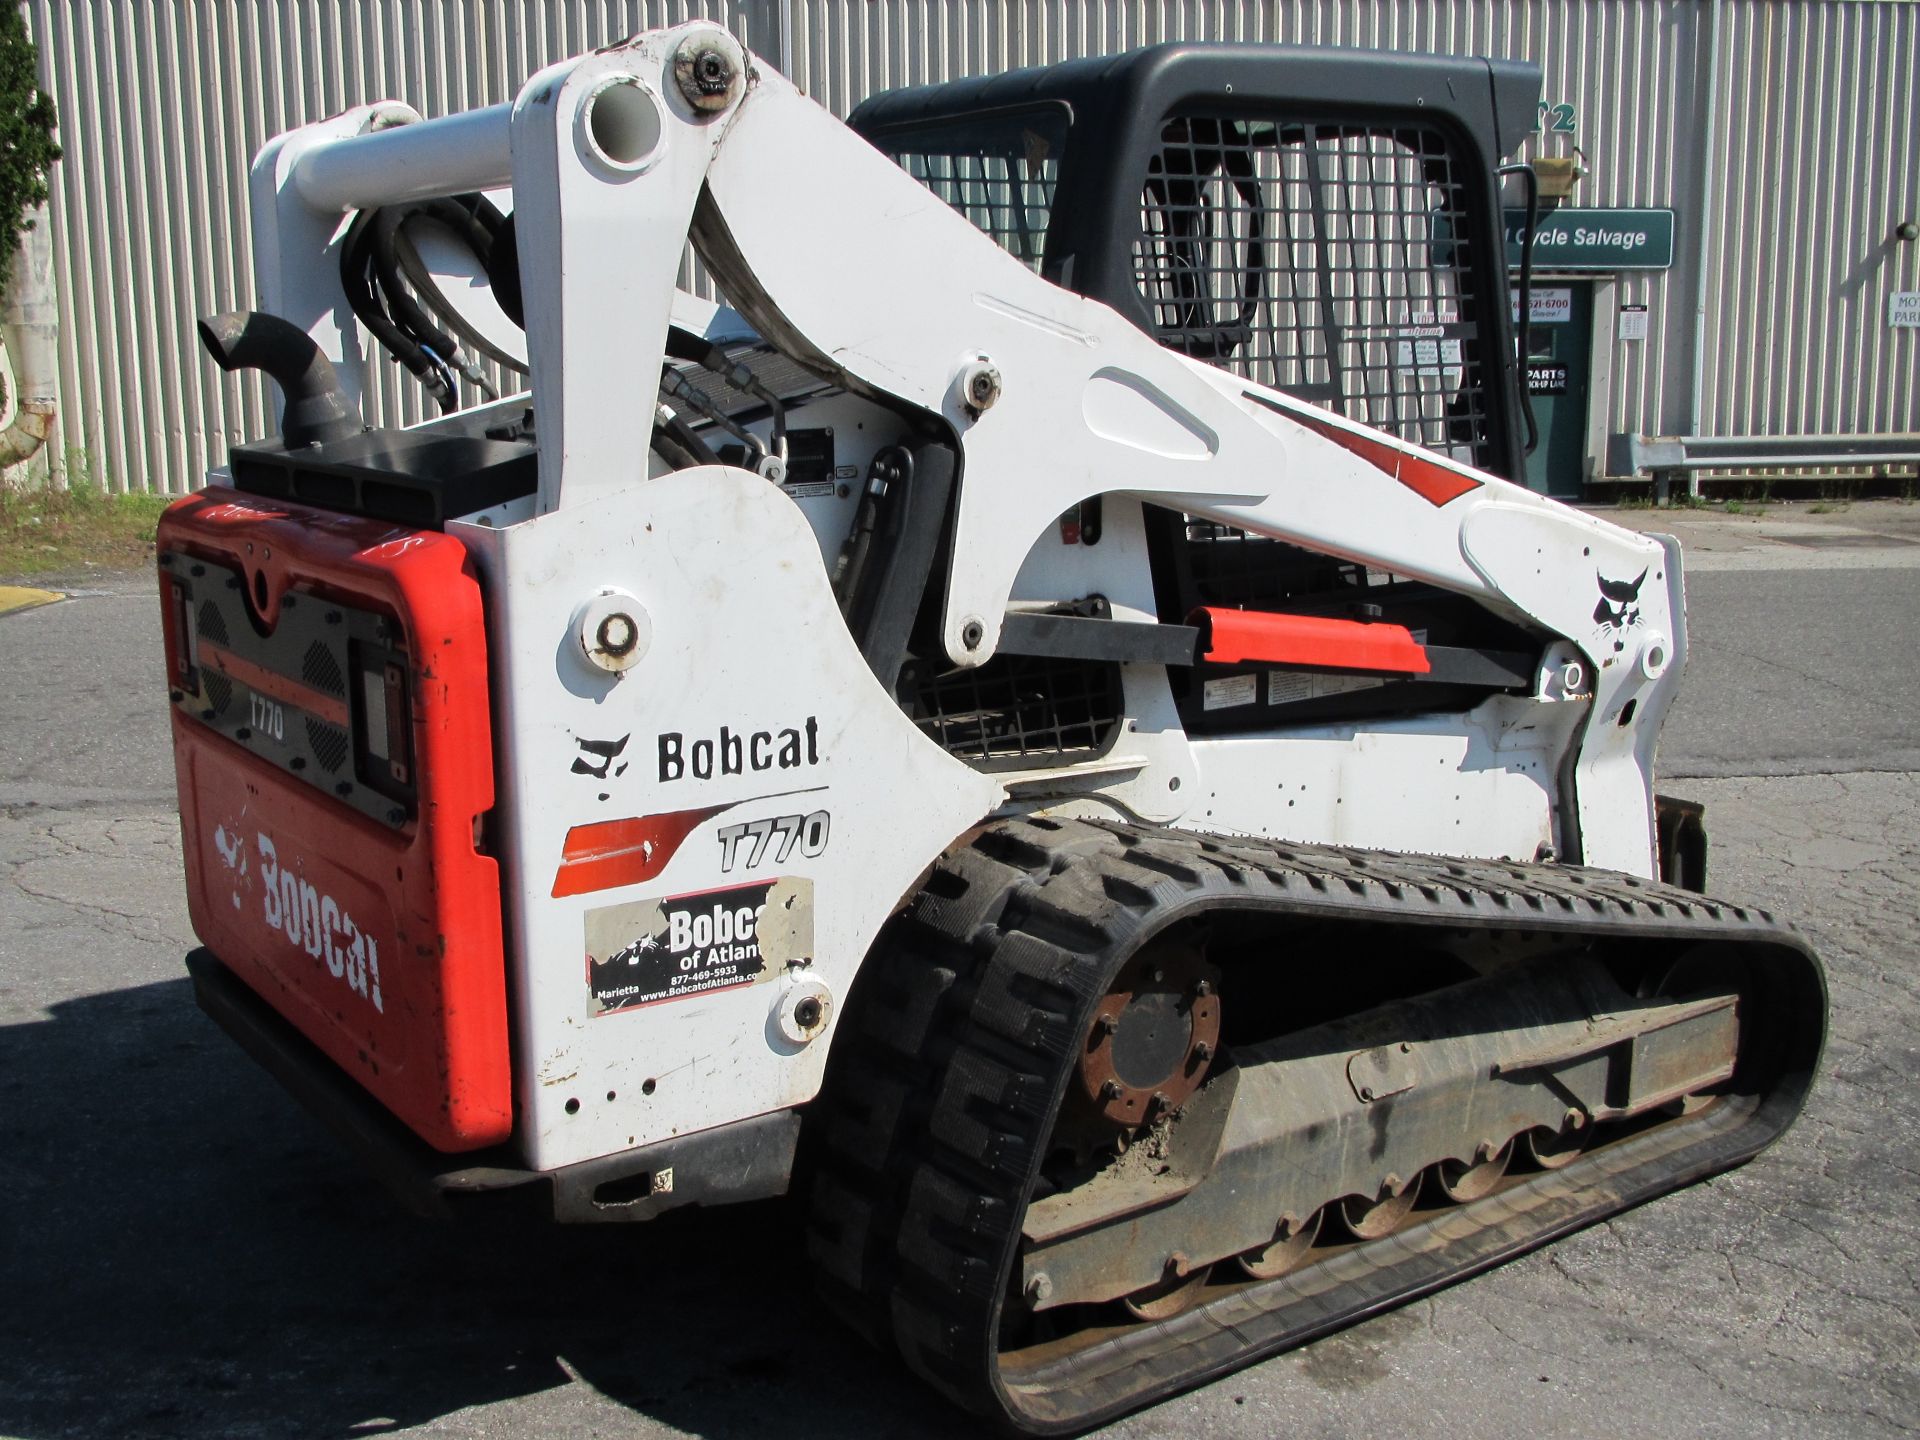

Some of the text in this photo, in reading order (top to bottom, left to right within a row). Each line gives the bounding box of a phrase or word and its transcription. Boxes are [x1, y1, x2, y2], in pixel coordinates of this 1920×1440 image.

[1574, 227, 1646, 250] Salvage
[1898, 296, 1920, 308] MO
[1894, 311, 1920, 322] PAR
[1527, 369, 1566, 380] PARTS
[1549, 380, 1565, 388] LANE
[250, 691, 284, 740] T770
[657, 715, 819, 783] Bobcat
[717, 809, 831, 873] T770
[679, 953, 701, 971] of
[670, 964, 738, 986] 877-469-5933
[597, 984, 640, 1001] Marietta
